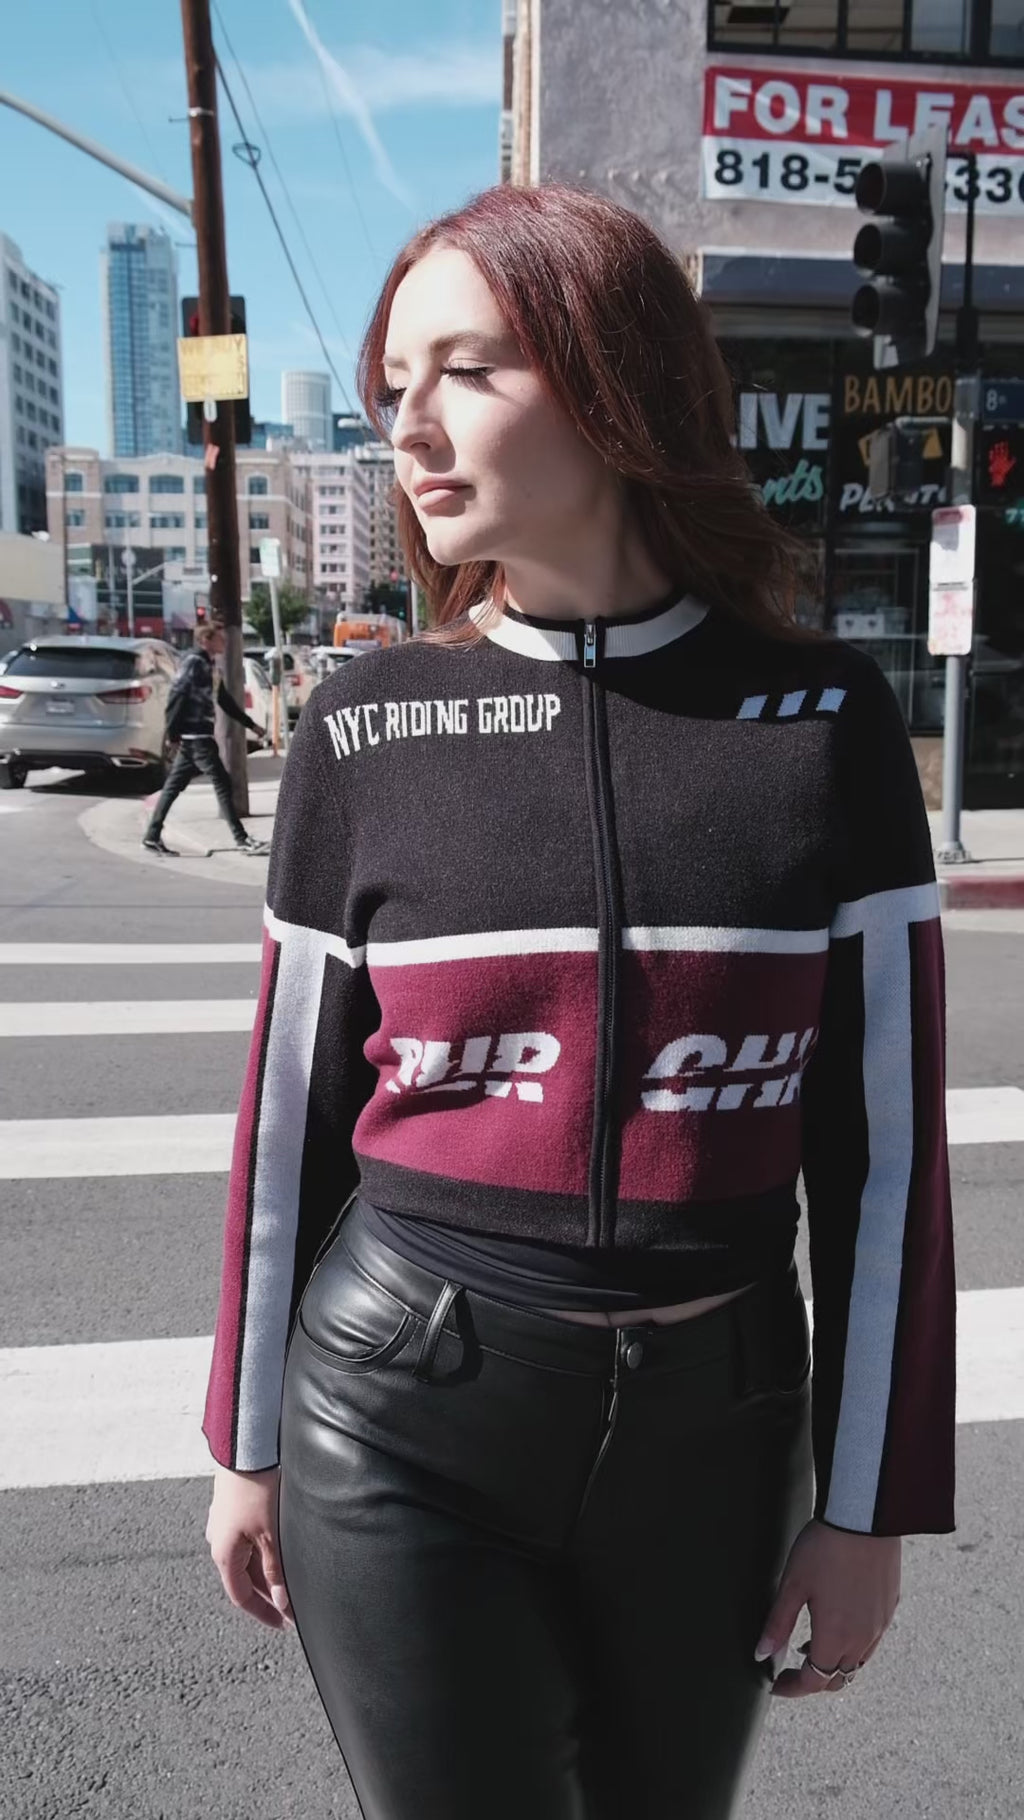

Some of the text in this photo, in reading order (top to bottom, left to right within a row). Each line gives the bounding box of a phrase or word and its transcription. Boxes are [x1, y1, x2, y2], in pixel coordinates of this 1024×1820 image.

[713, 75, 850, 138] FOR
[730, 392, 831, 450] IVE
[762, 459, 824, 506] nts
[323, 693, 561, 760] NYC RIDING GROUP
